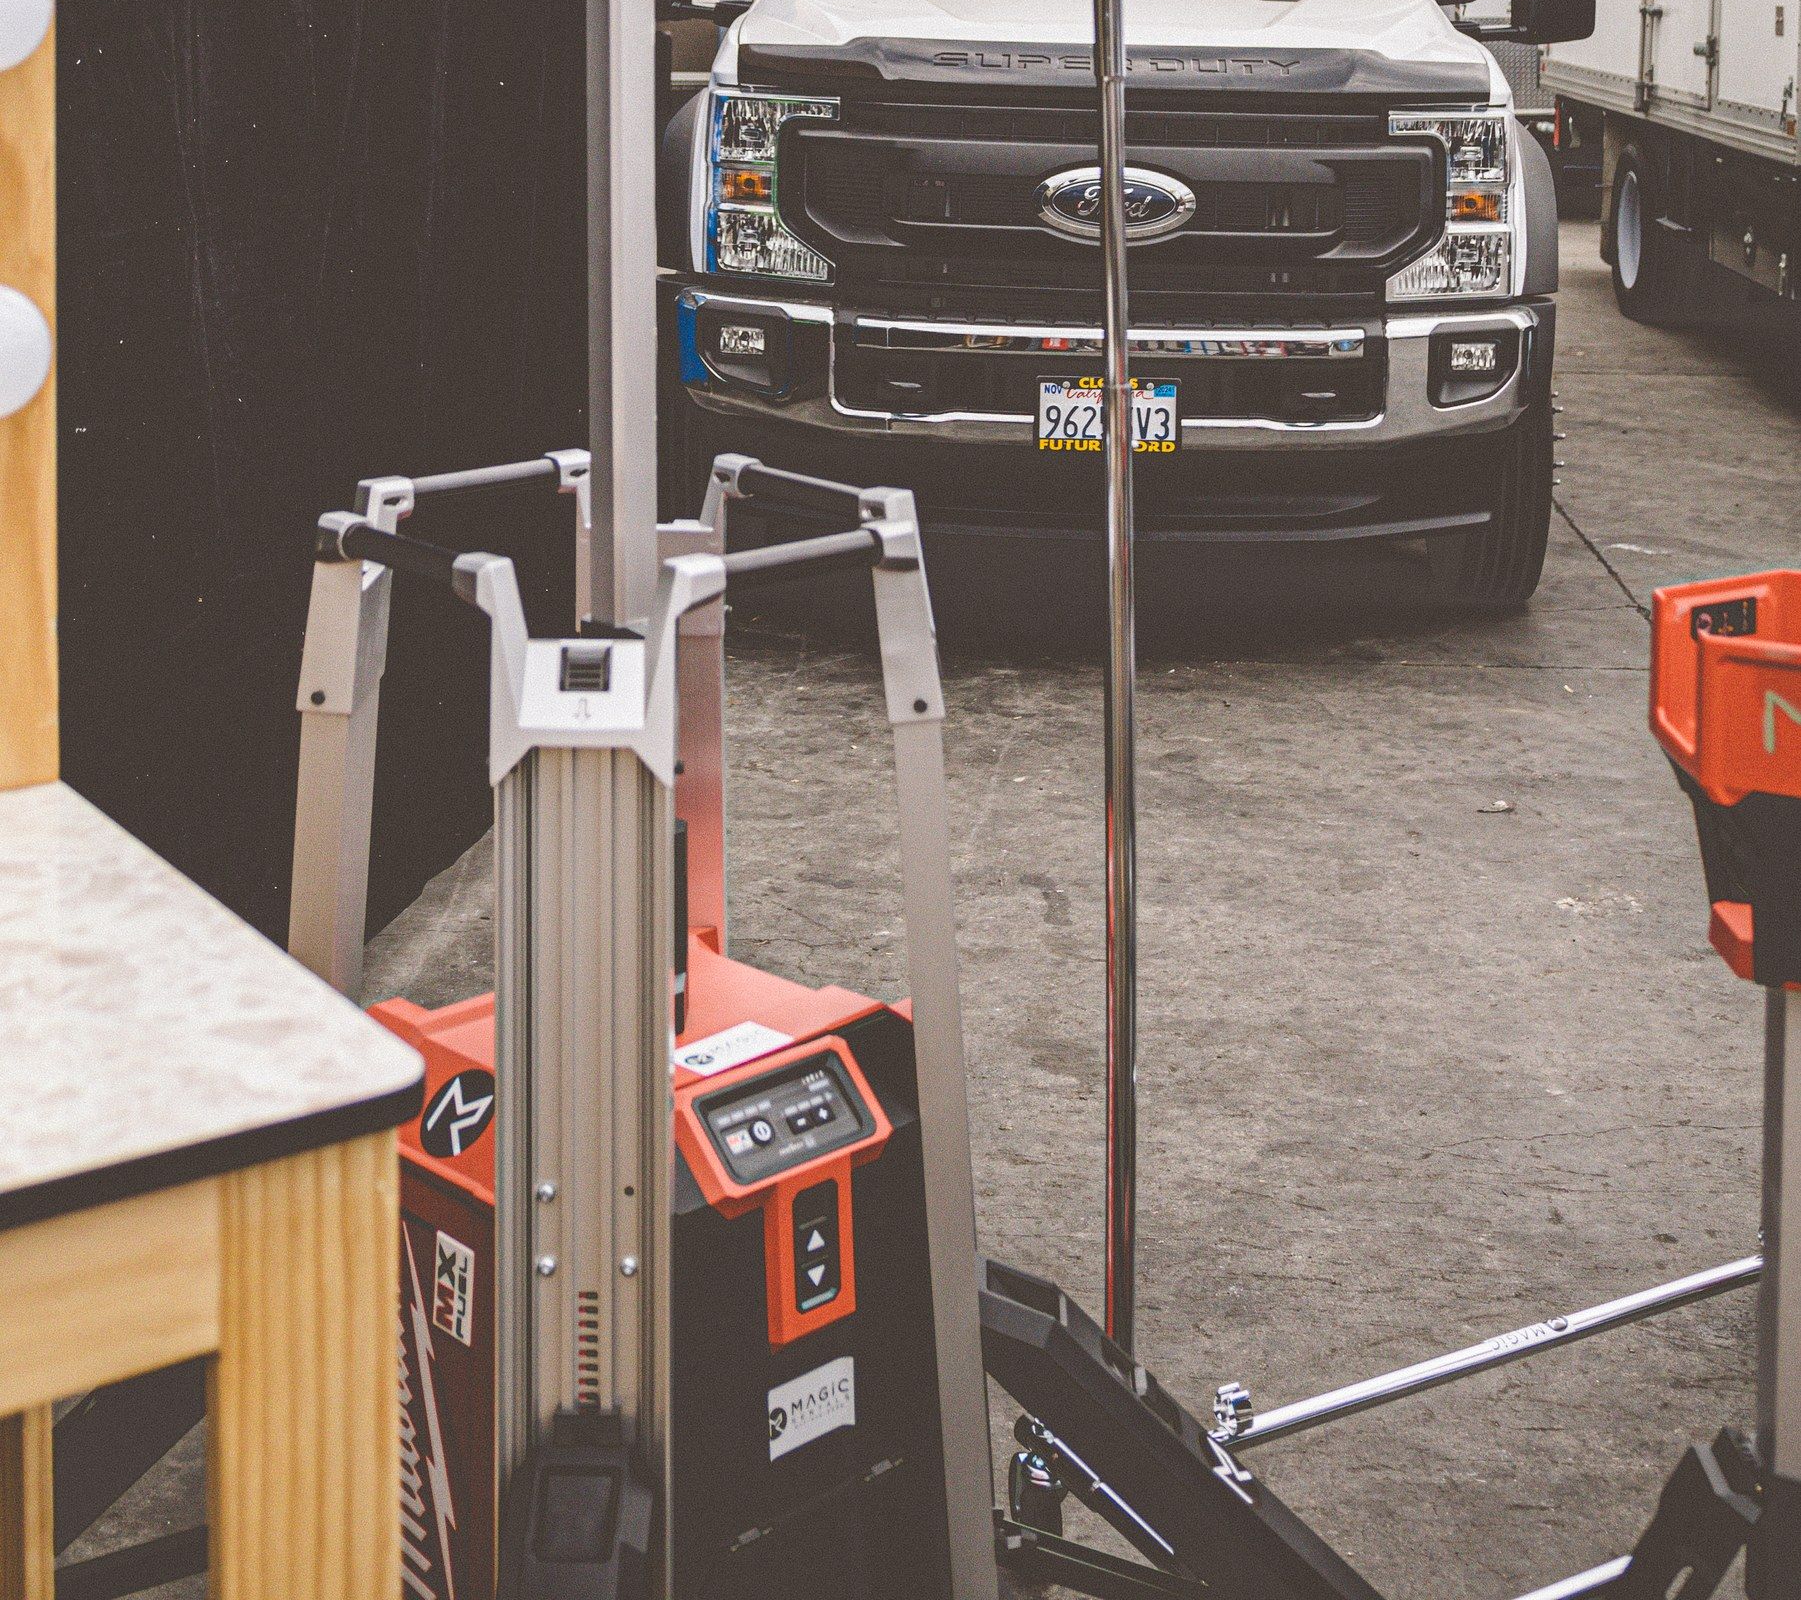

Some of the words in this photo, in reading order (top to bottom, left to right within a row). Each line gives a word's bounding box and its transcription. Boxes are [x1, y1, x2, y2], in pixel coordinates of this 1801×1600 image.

[933, 51, 1132, 72] SUPE
[1149, 56, 1300, 77] DUTY
[1077, 185, 1153, 218] Fd
[1044, 384, 1062, 395] NOV
[1066, 388, 1153, 404] Califa
[1078, 376, 1139, 390] CLOS
[1045, 405, 1170, 440] 962V3
[1039, 439, 1103, 452] FUTUR
[1130, 440, 1176, 453] ORD
[436, 1243, 457, 1332] MX
[456, 1256, 468, 1339] FUEL
